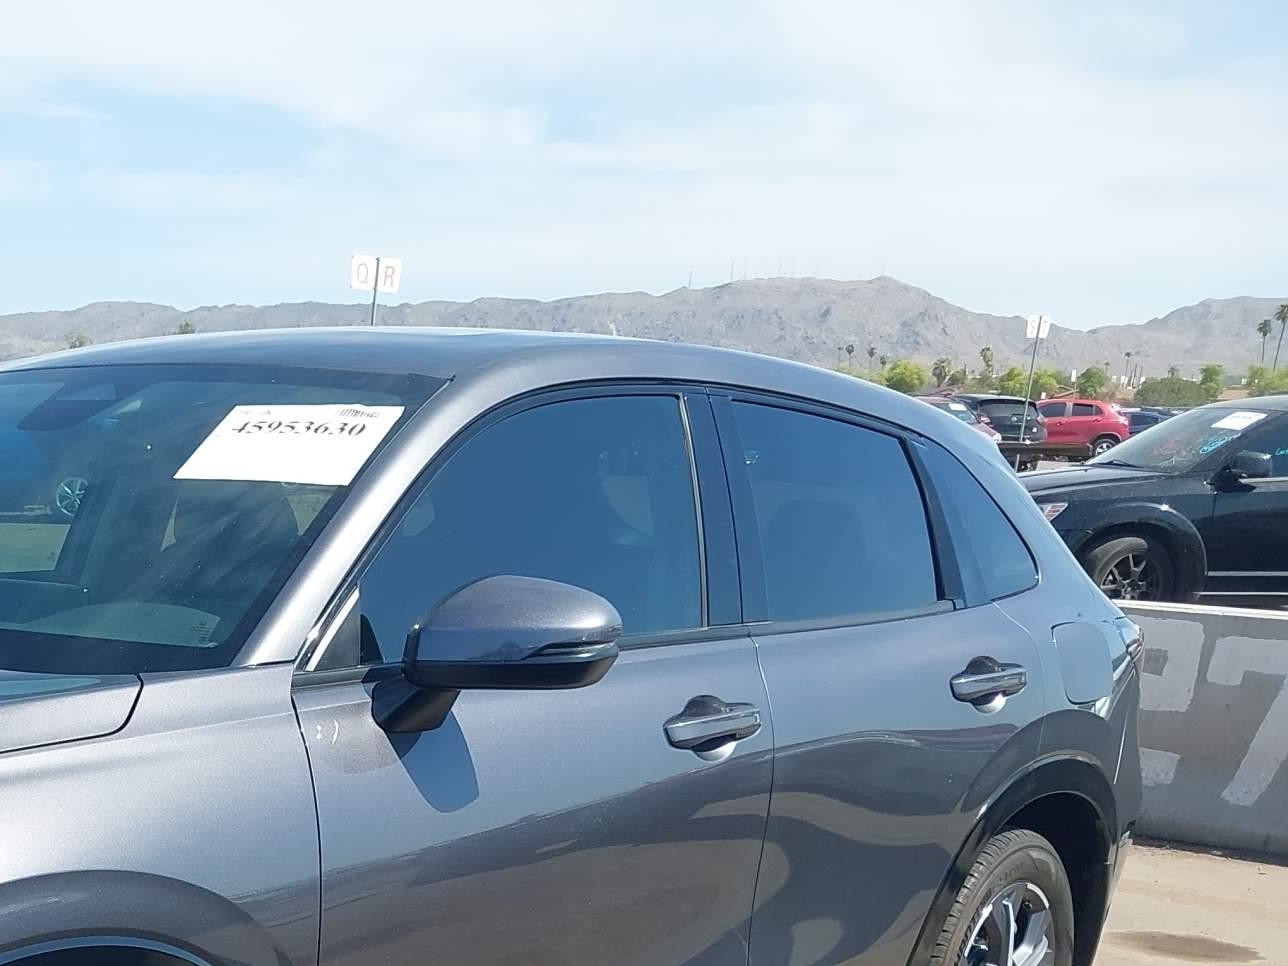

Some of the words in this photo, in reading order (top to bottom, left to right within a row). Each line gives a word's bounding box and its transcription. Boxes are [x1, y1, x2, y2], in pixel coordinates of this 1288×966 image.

[356, 262, 369, 285] Q
[383, 265, 396, 288] R
[232, 420, 366, 437] 45953630
